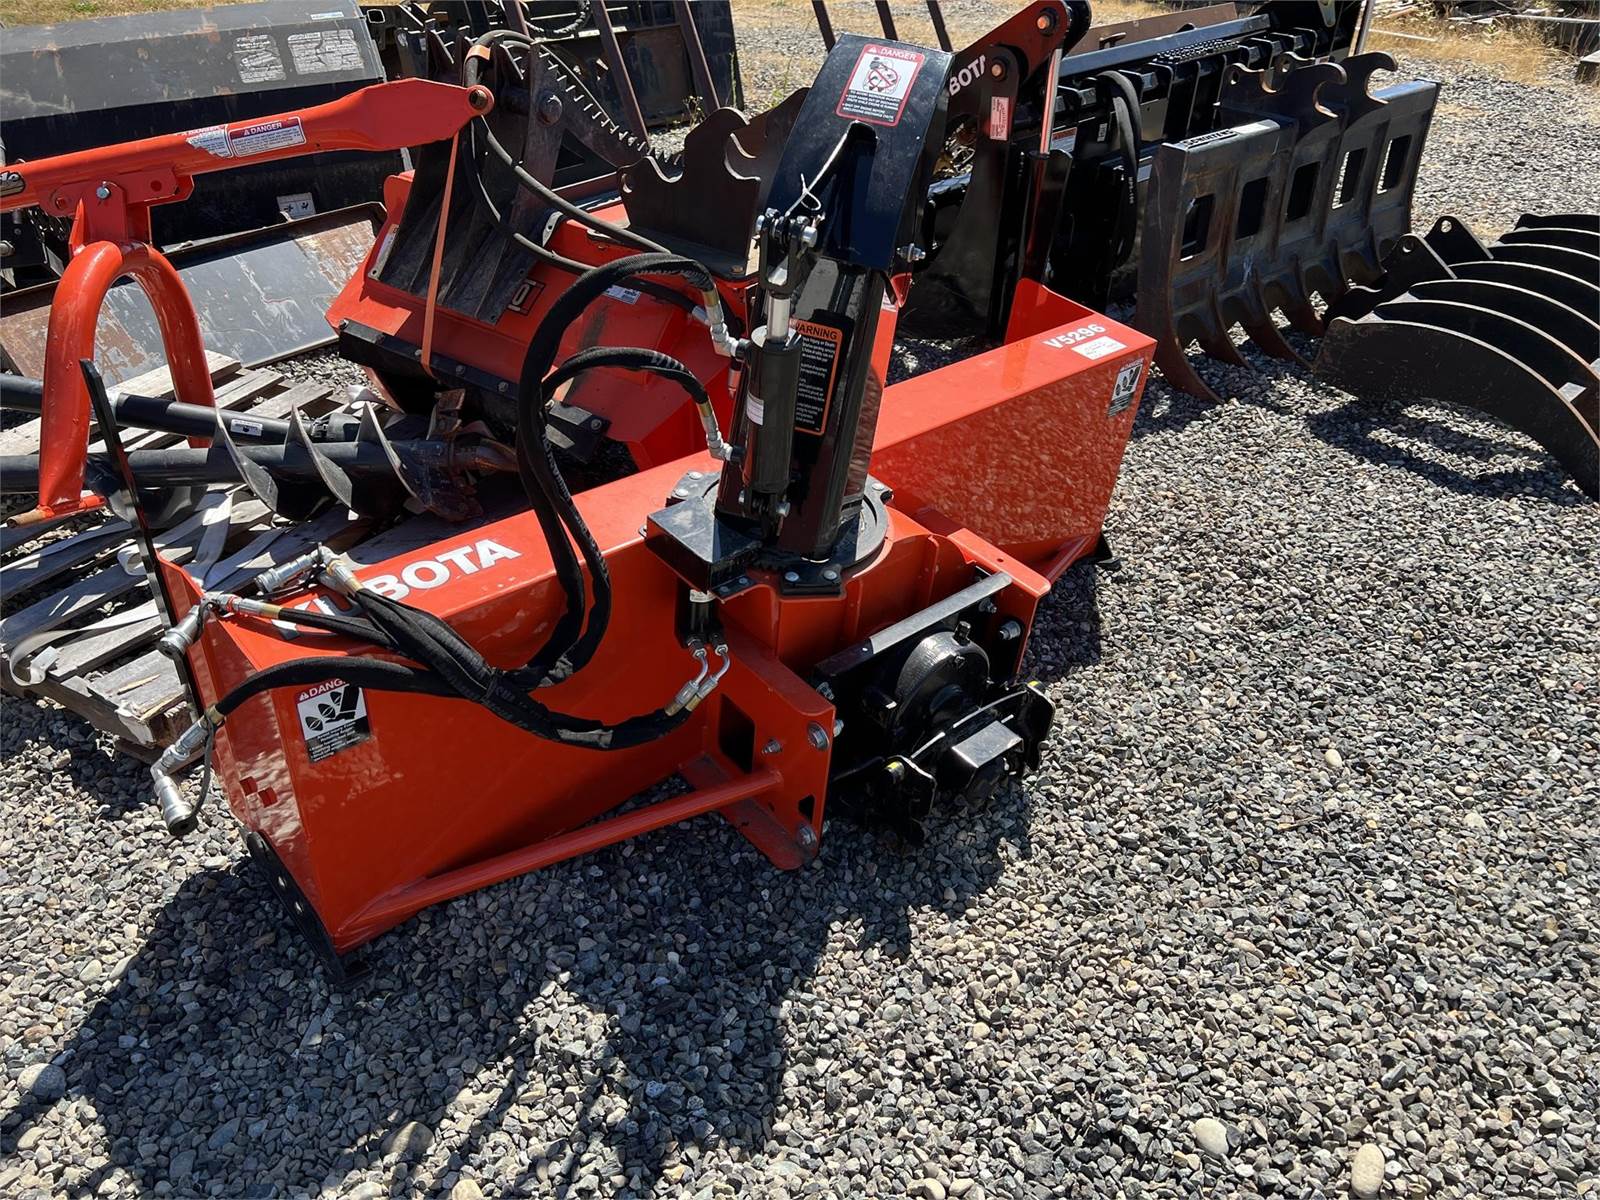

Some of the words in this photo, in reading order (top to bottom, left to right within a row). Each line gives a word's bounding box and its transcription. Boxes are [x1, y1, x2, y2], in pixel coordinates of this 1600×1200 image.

[880, 48, 917, 60] DANGER
[250, 122, 283, 134] DANGER
[1042, 323, 1106, 349] V5296
[309, 678, 347, 697] DANG
